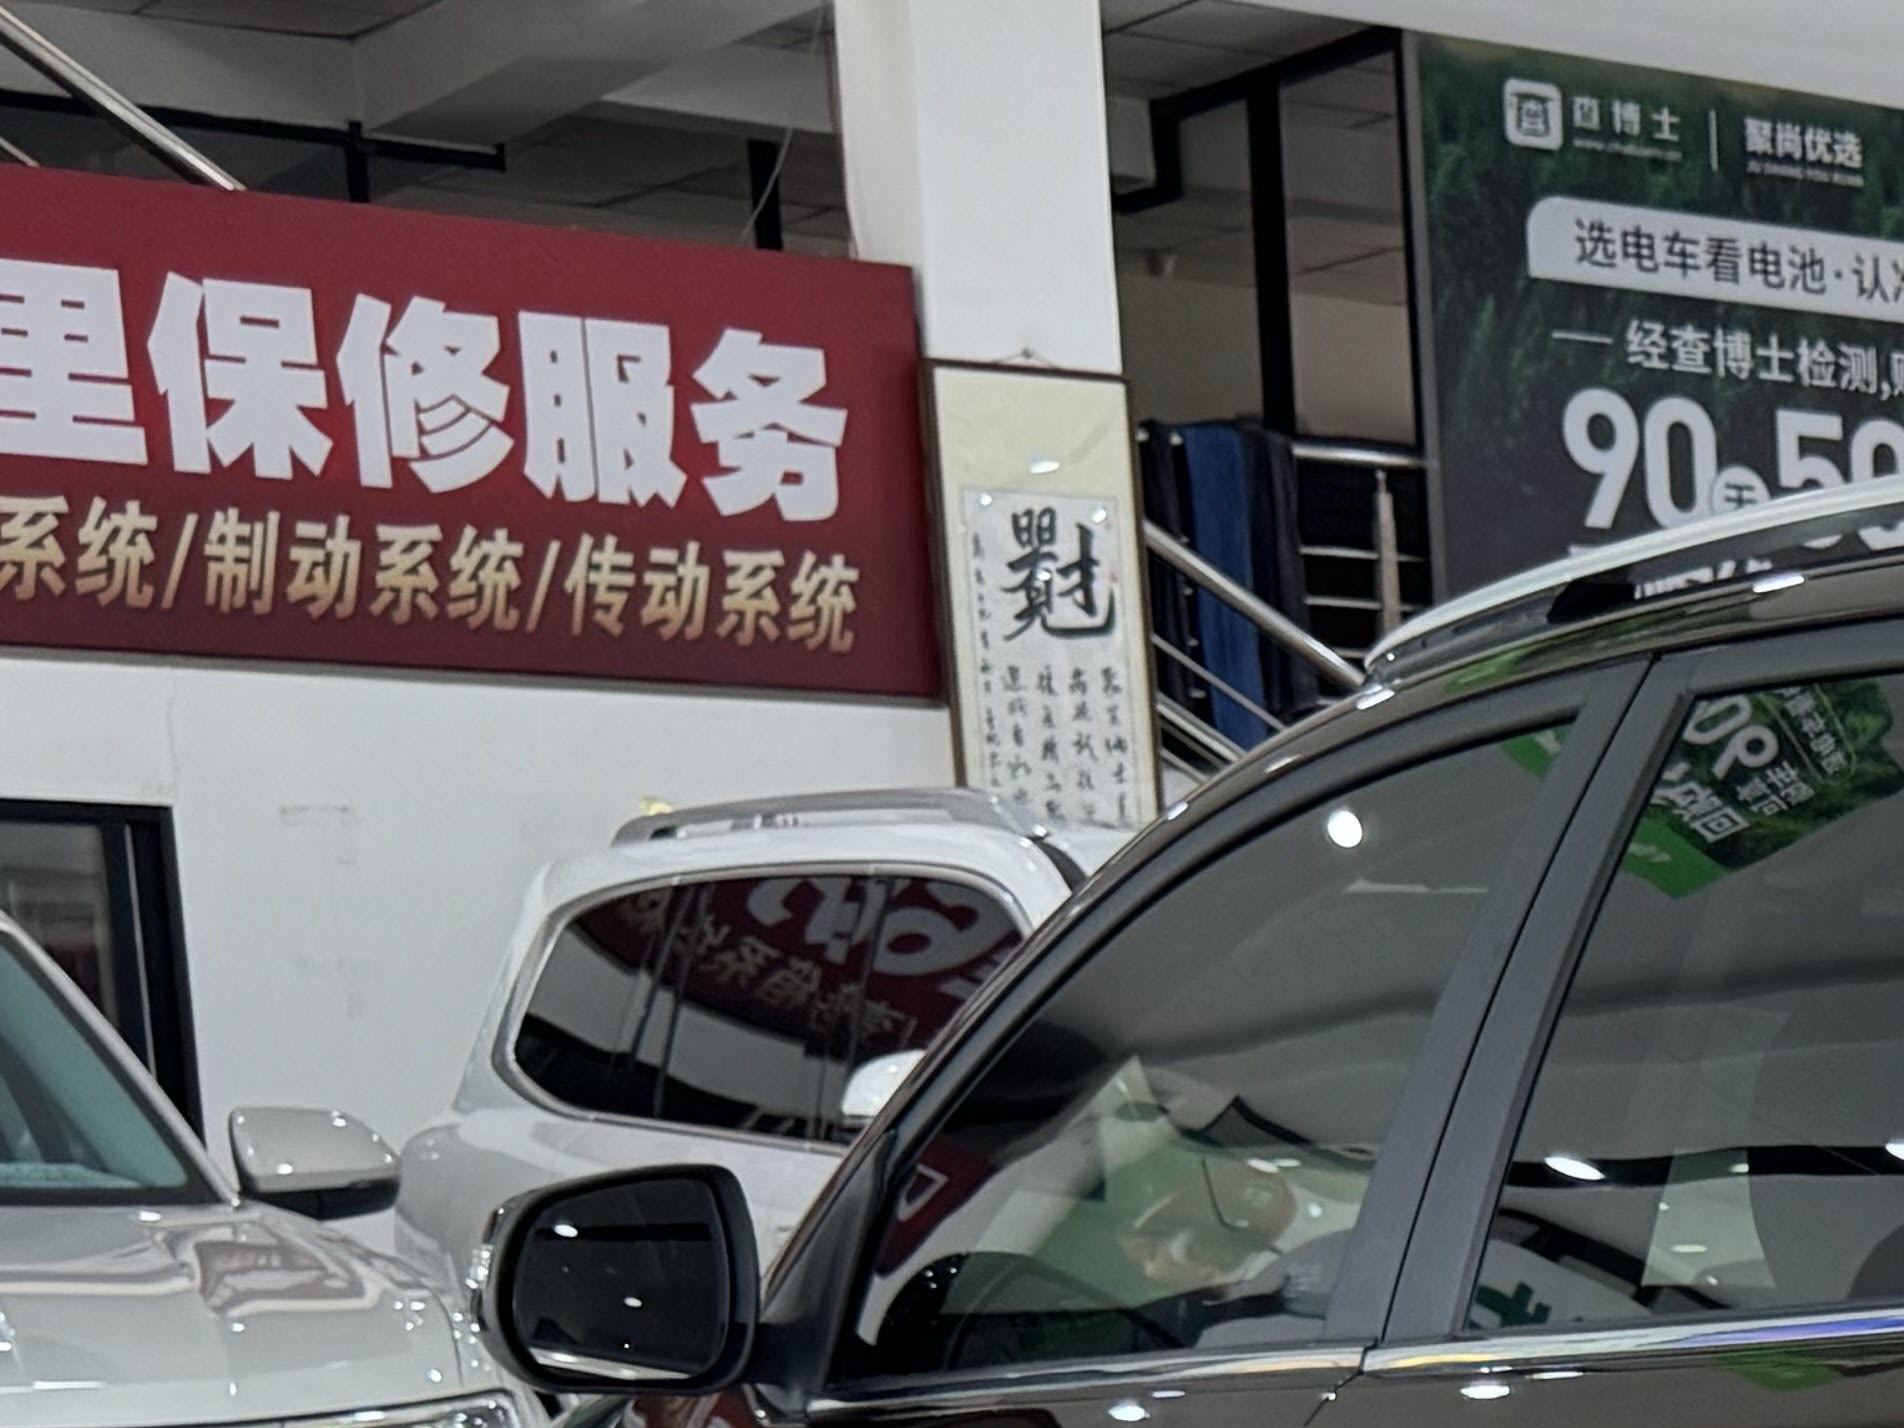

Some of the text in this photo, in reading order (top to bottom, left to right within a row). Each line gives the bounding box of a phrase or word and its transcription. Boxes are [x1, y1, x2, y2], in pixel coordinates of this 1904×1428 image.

[0, 258, 848, 522] 里保修服务
[1562, 388, 1719, 530] 90
[0, 495, 860, 653] 系统/制动系统/传动系统
